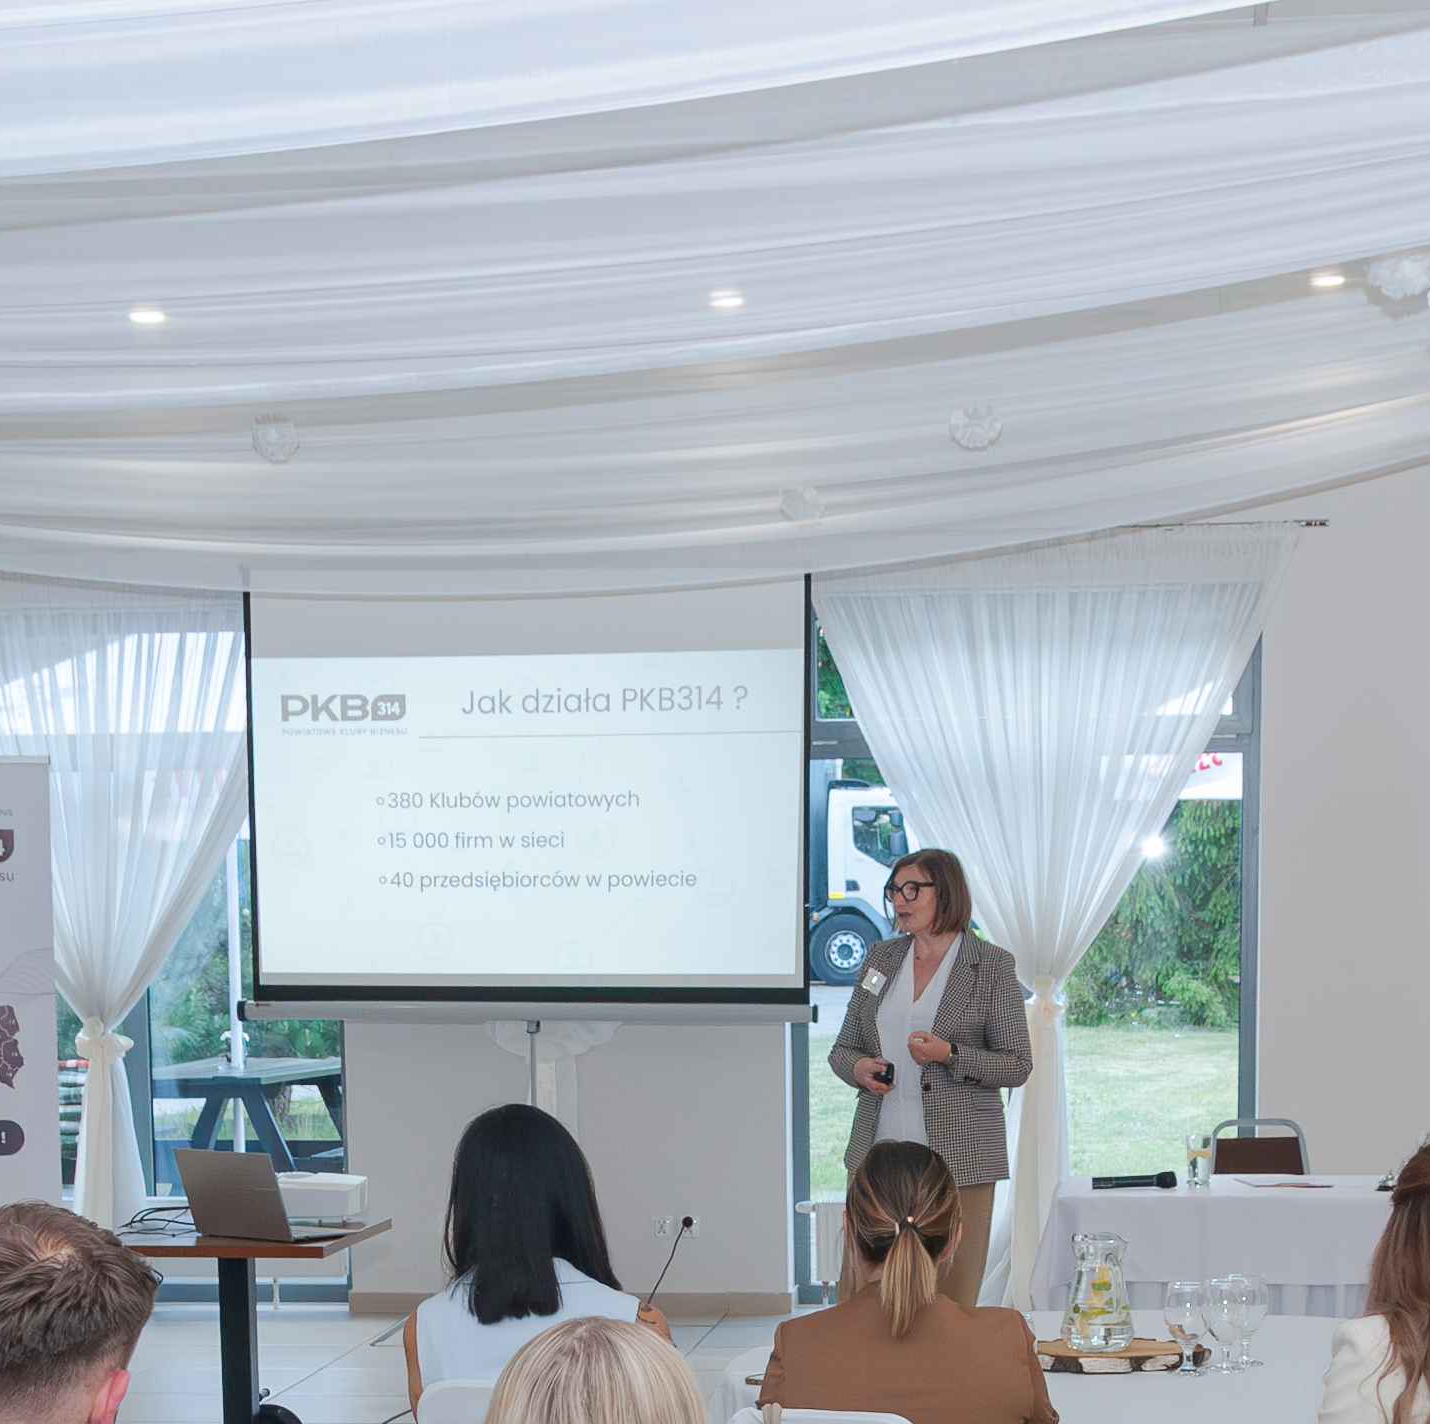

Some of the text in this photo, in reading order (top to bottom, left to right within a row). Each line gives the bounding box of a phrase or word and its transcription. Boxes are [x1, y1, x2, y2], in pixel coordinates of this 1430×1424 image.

[280, 694, 401, 722] PKB 314
[462, 685, 748, 714] Jak działa PKB314 ?
[282, 727, 408, 736] POWIATOWE KLUBY BIZNESU
[387, 790, 640, 813] 380 Klubów powiatowych
[388, 831, 565, 849] 15 000 firm w sieci
[390, 870, 697, 892] 40 przedsiębiorców w powiecie
